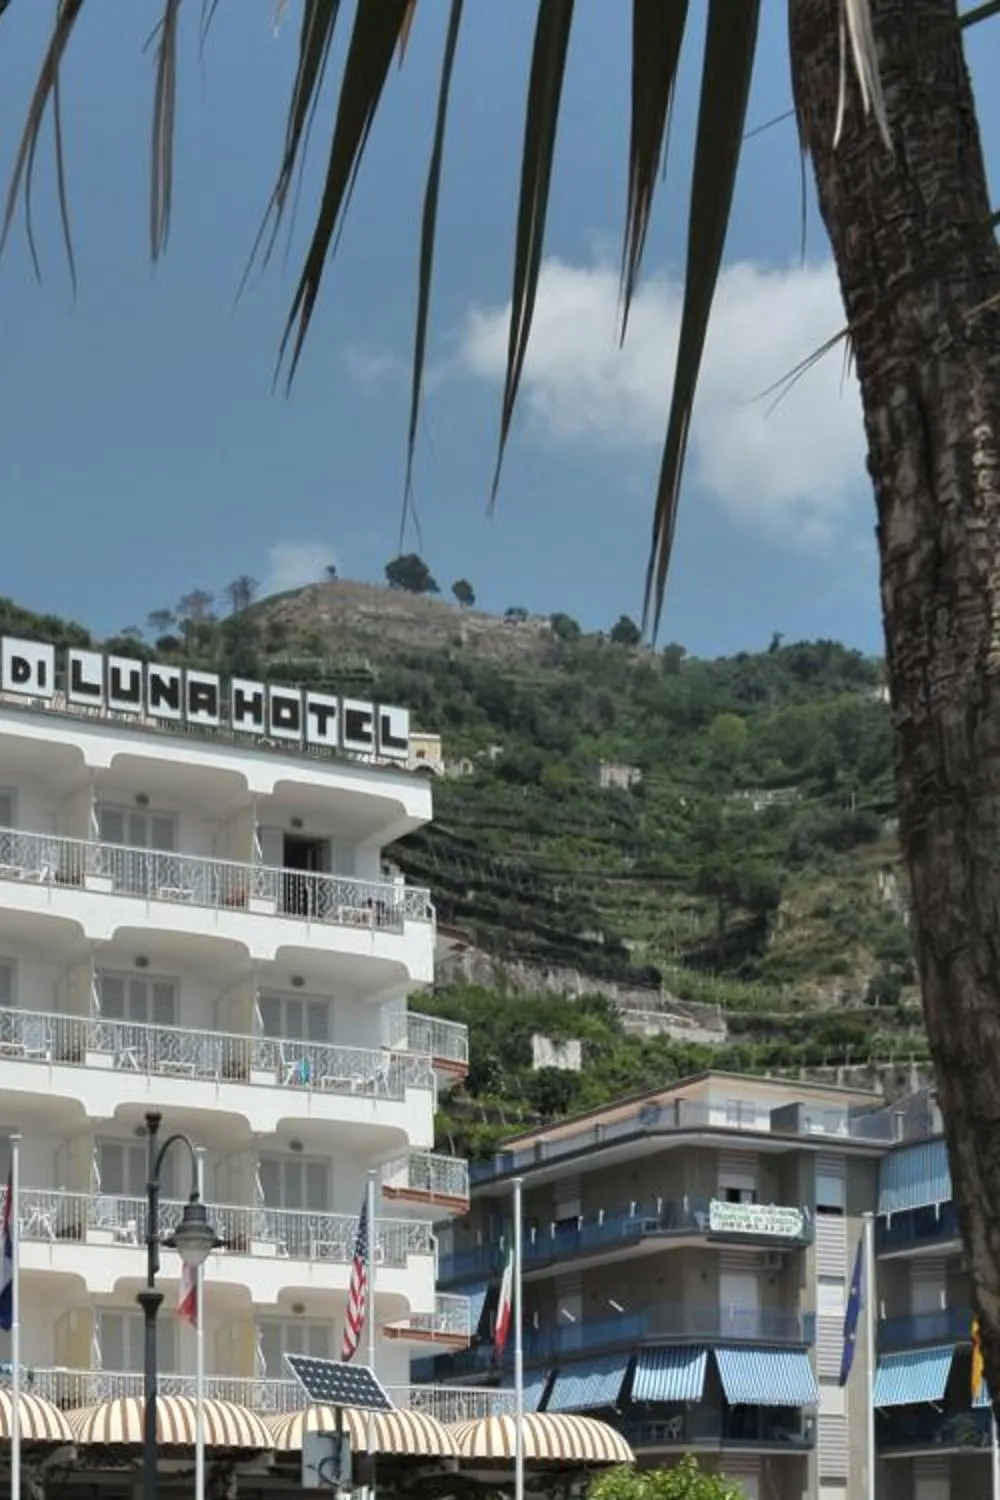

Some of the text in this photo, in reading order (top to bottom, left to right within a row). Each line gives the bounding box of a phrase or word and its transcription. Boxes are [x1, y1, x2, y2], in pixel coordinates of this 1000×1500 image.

[11, 655, 47, 688] DI
[71, 659, 218, 717] LUNA
[235, 688, 407, 750] HOTEL
